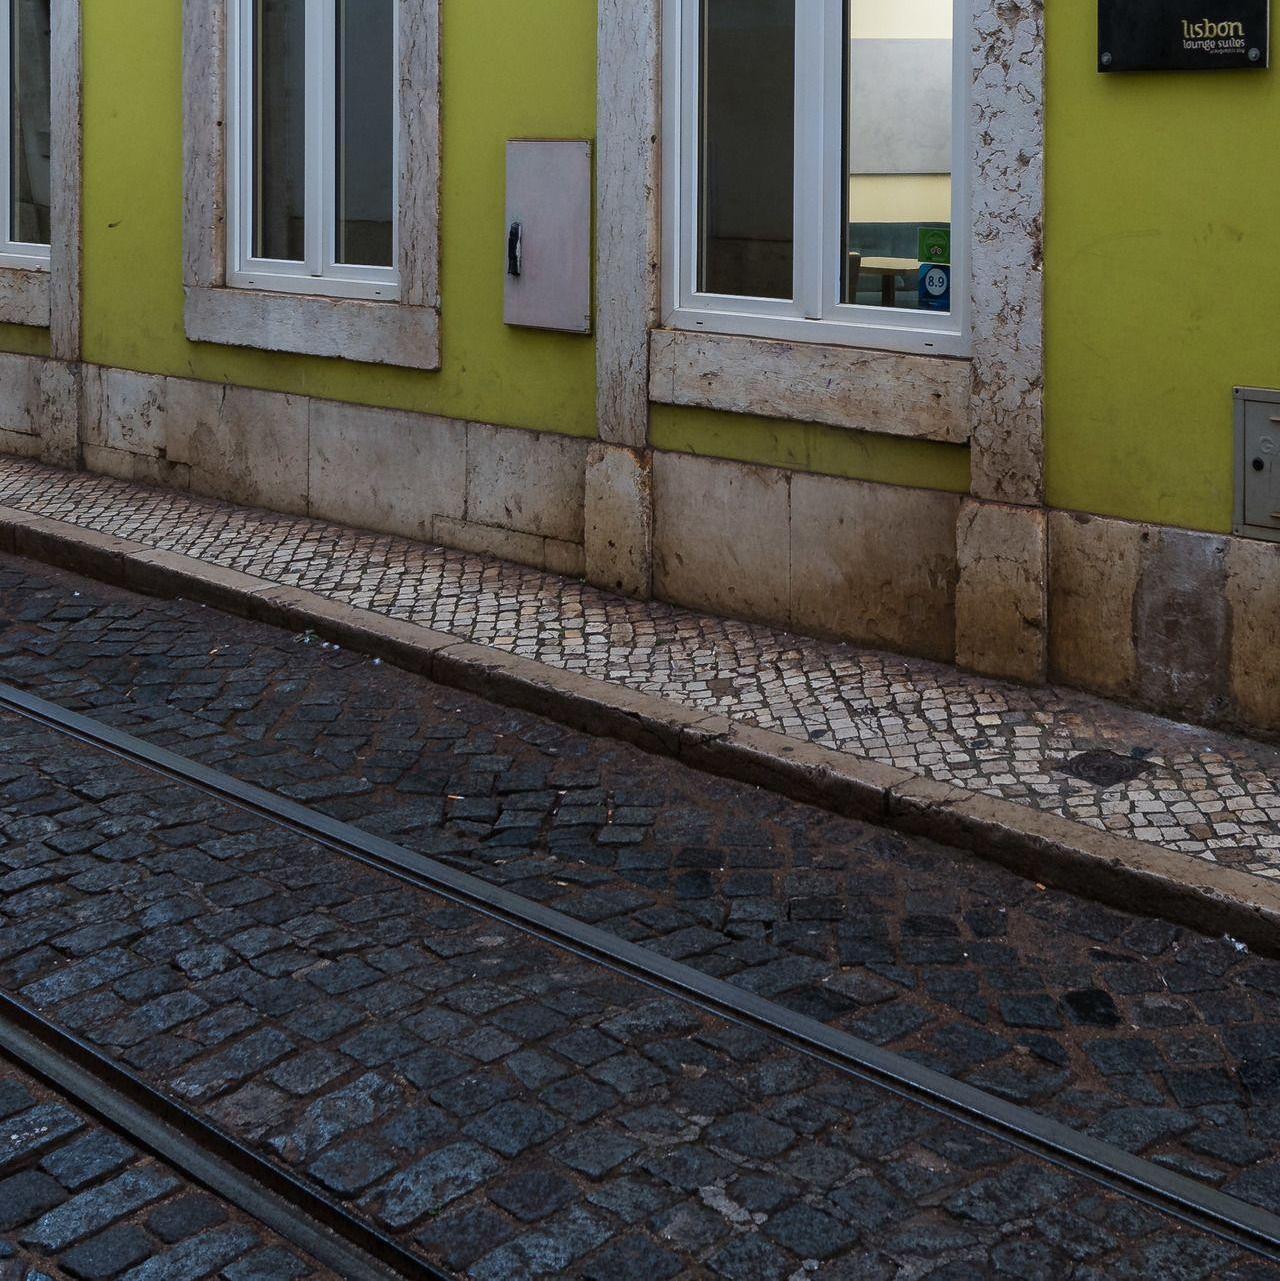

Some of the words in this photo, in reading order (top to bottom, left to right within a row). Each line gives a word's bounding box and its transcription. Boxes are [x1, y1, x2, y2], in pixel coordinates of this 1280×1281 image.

[1181, 19, 1245, 38] lisbon
[1183, 39, 1215, 51] lounge
[1217, 38, 1245, 48] suites
[928, 276, 945, 287] 8.9
